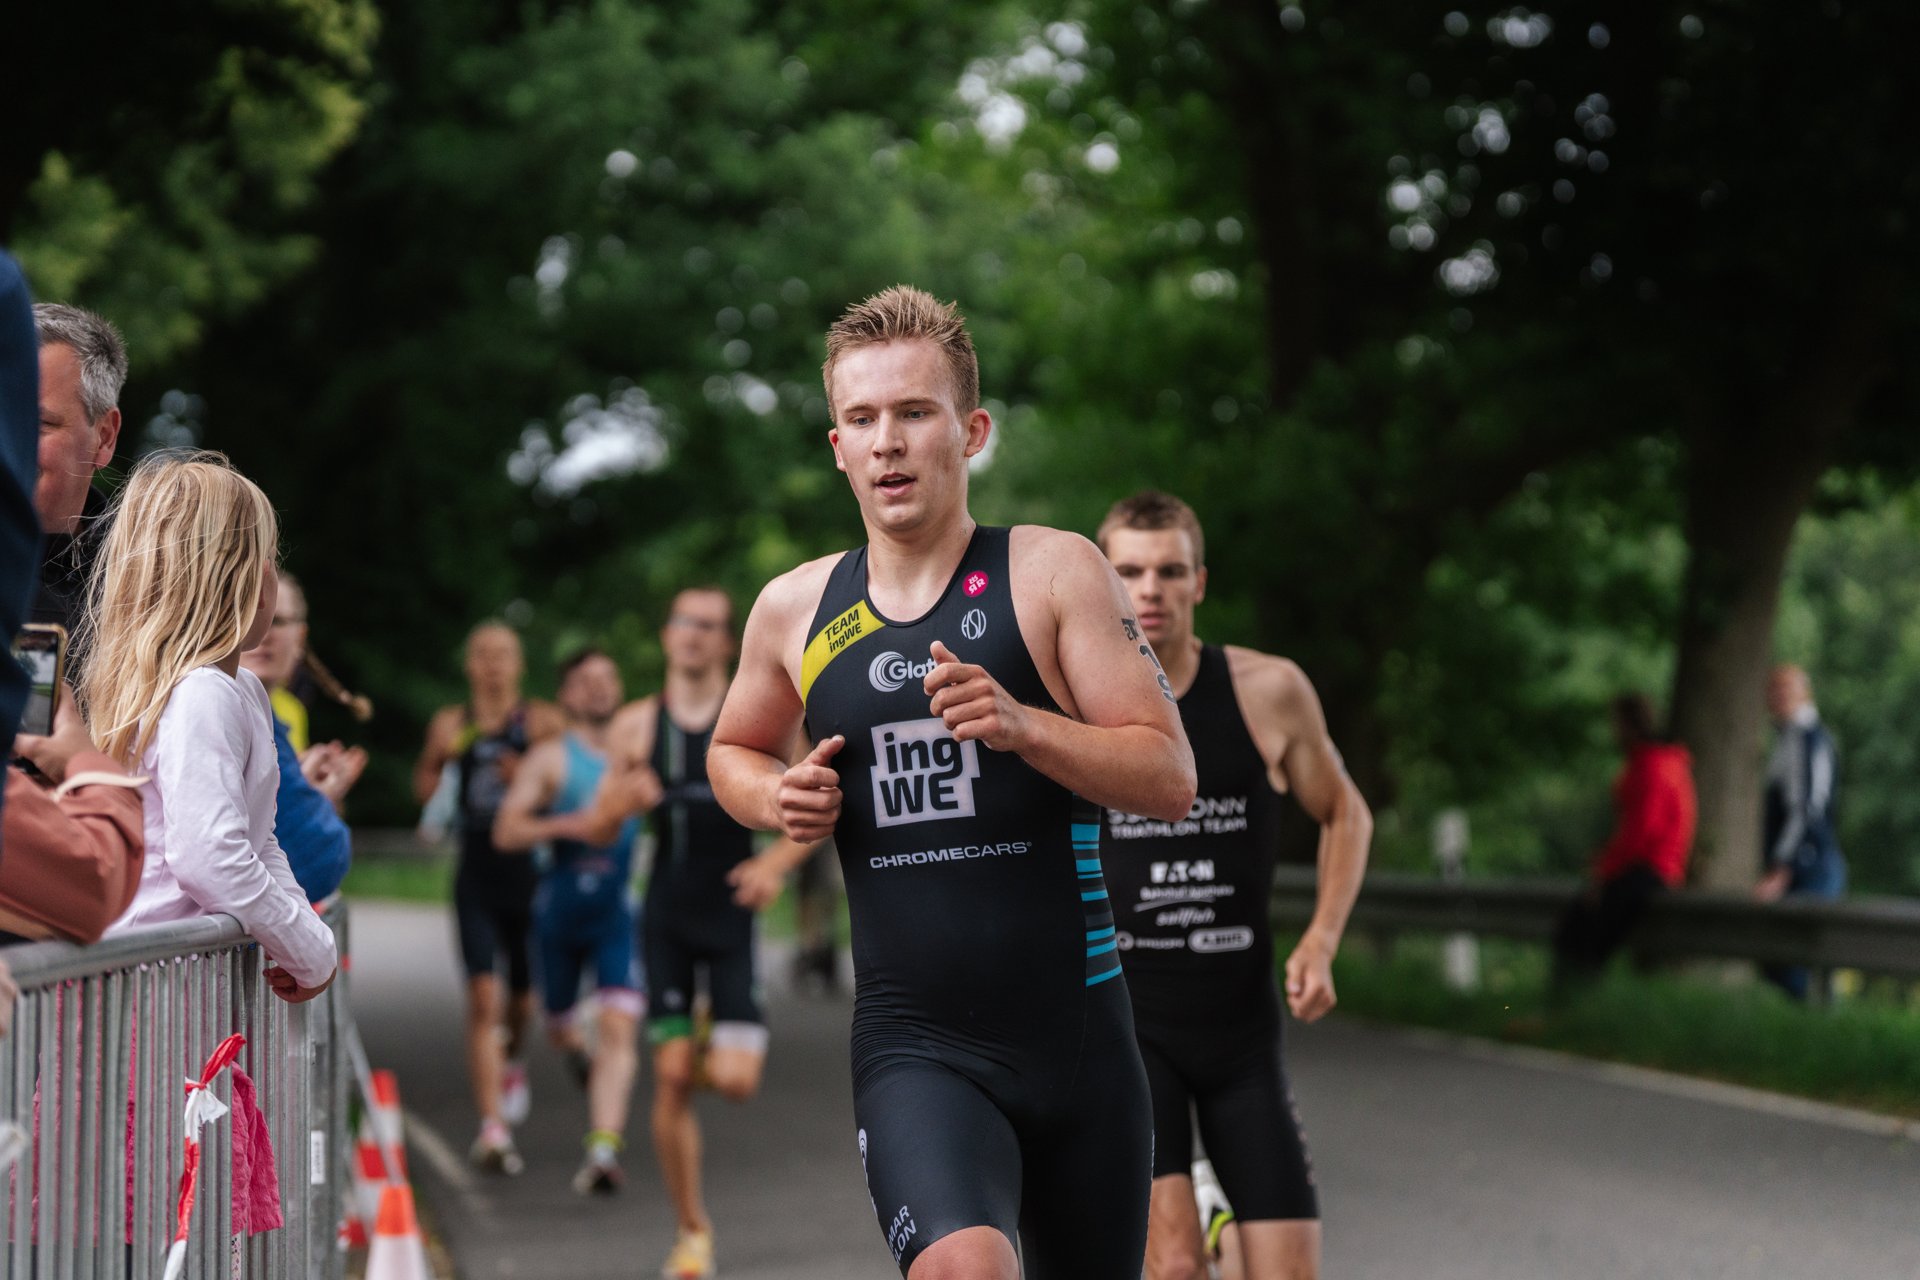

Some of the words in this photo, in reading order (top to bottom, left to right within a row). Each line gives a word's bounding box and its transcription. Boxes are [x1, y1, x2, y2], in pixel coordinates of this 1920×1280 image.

[825, 609, 860, 641] TEAM
[829, 622, 862, 653] ingWE
[888, 658, 938, 681] Glat
[883, 731, 964, 781] ing
[879, 773, 960, 818] WE
[1187, 796, 1249, 820] ONN
